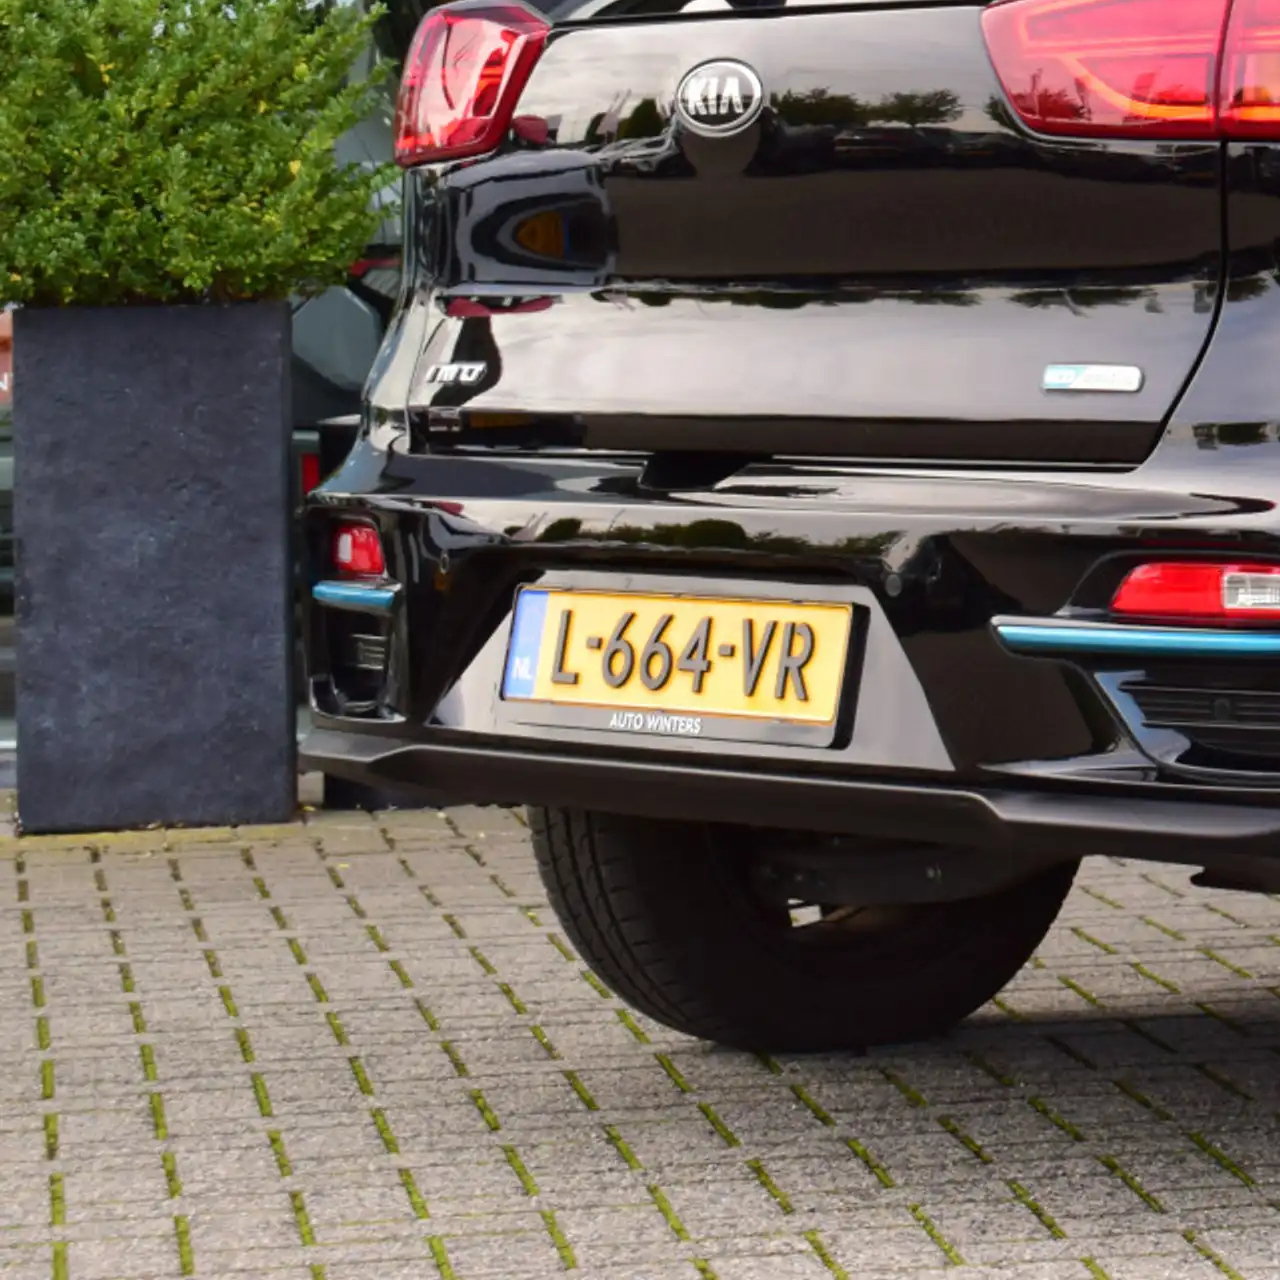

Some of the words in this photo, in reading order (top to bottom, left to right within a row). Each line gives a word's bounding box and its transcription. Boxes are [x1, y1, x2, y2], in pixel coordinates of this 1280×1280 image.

[686, 76, 744, 116] KIA
[551, 608, 816, 702] L-664-VR
[609, 712, 644, 730] AUTO
[646, 714, 702, 734] WINTERS
